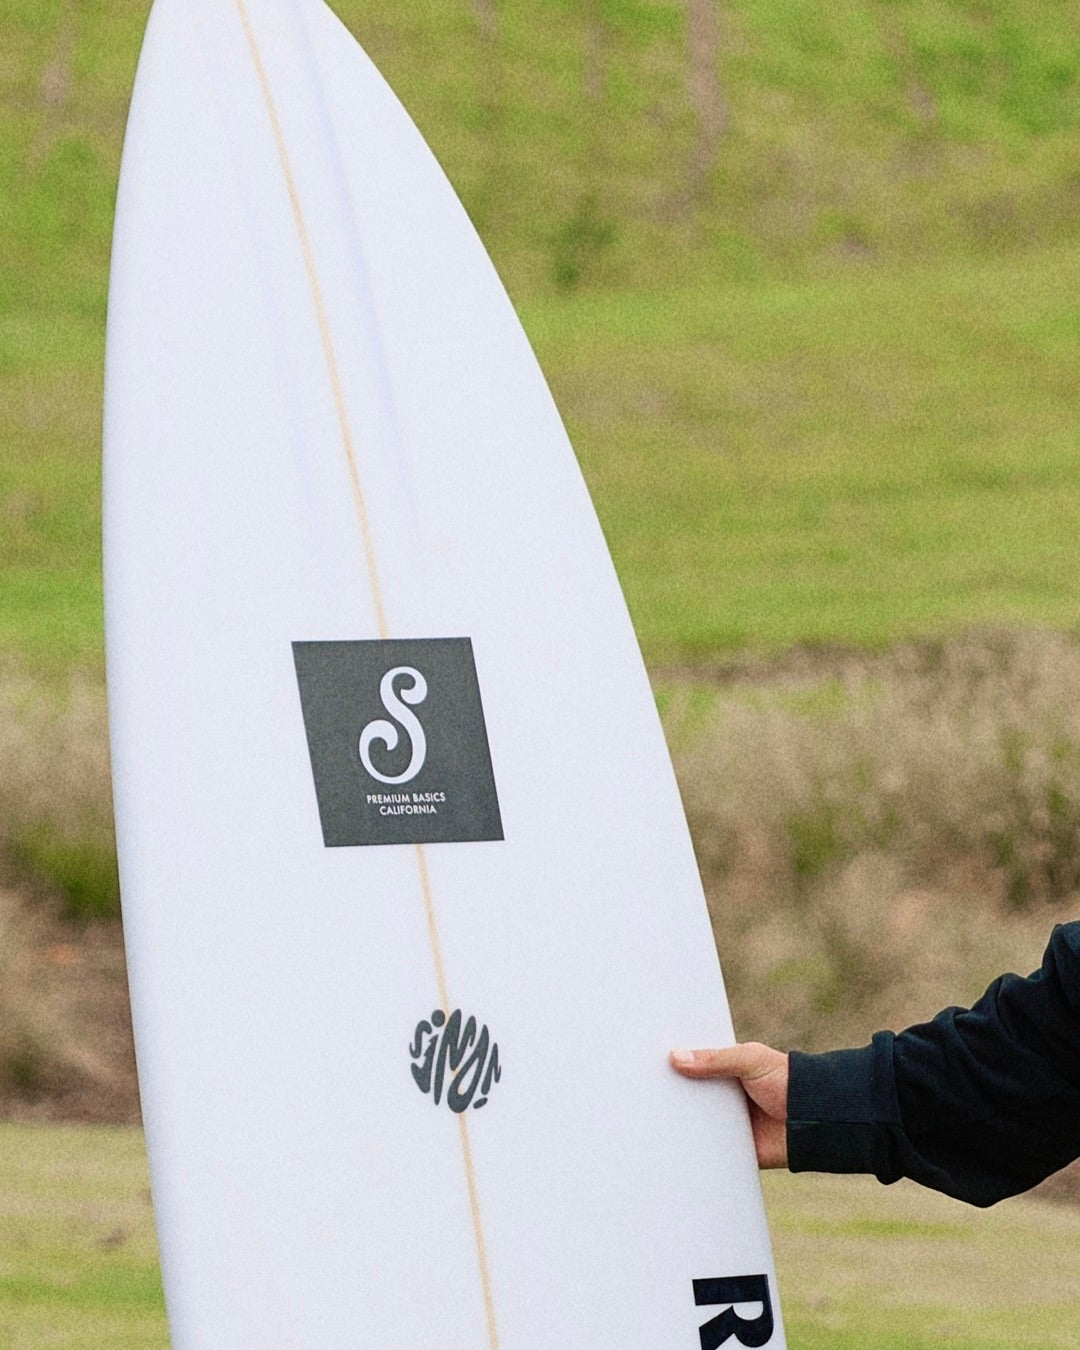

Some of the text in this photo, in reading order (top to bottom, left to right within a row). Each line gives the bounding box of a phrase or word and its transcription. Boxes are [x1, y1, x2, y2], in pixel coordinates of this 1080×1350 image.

[366, 792, 446, 804] PREMIUM BASICS
[379, 804, 437, 815] CALIFORNIA
